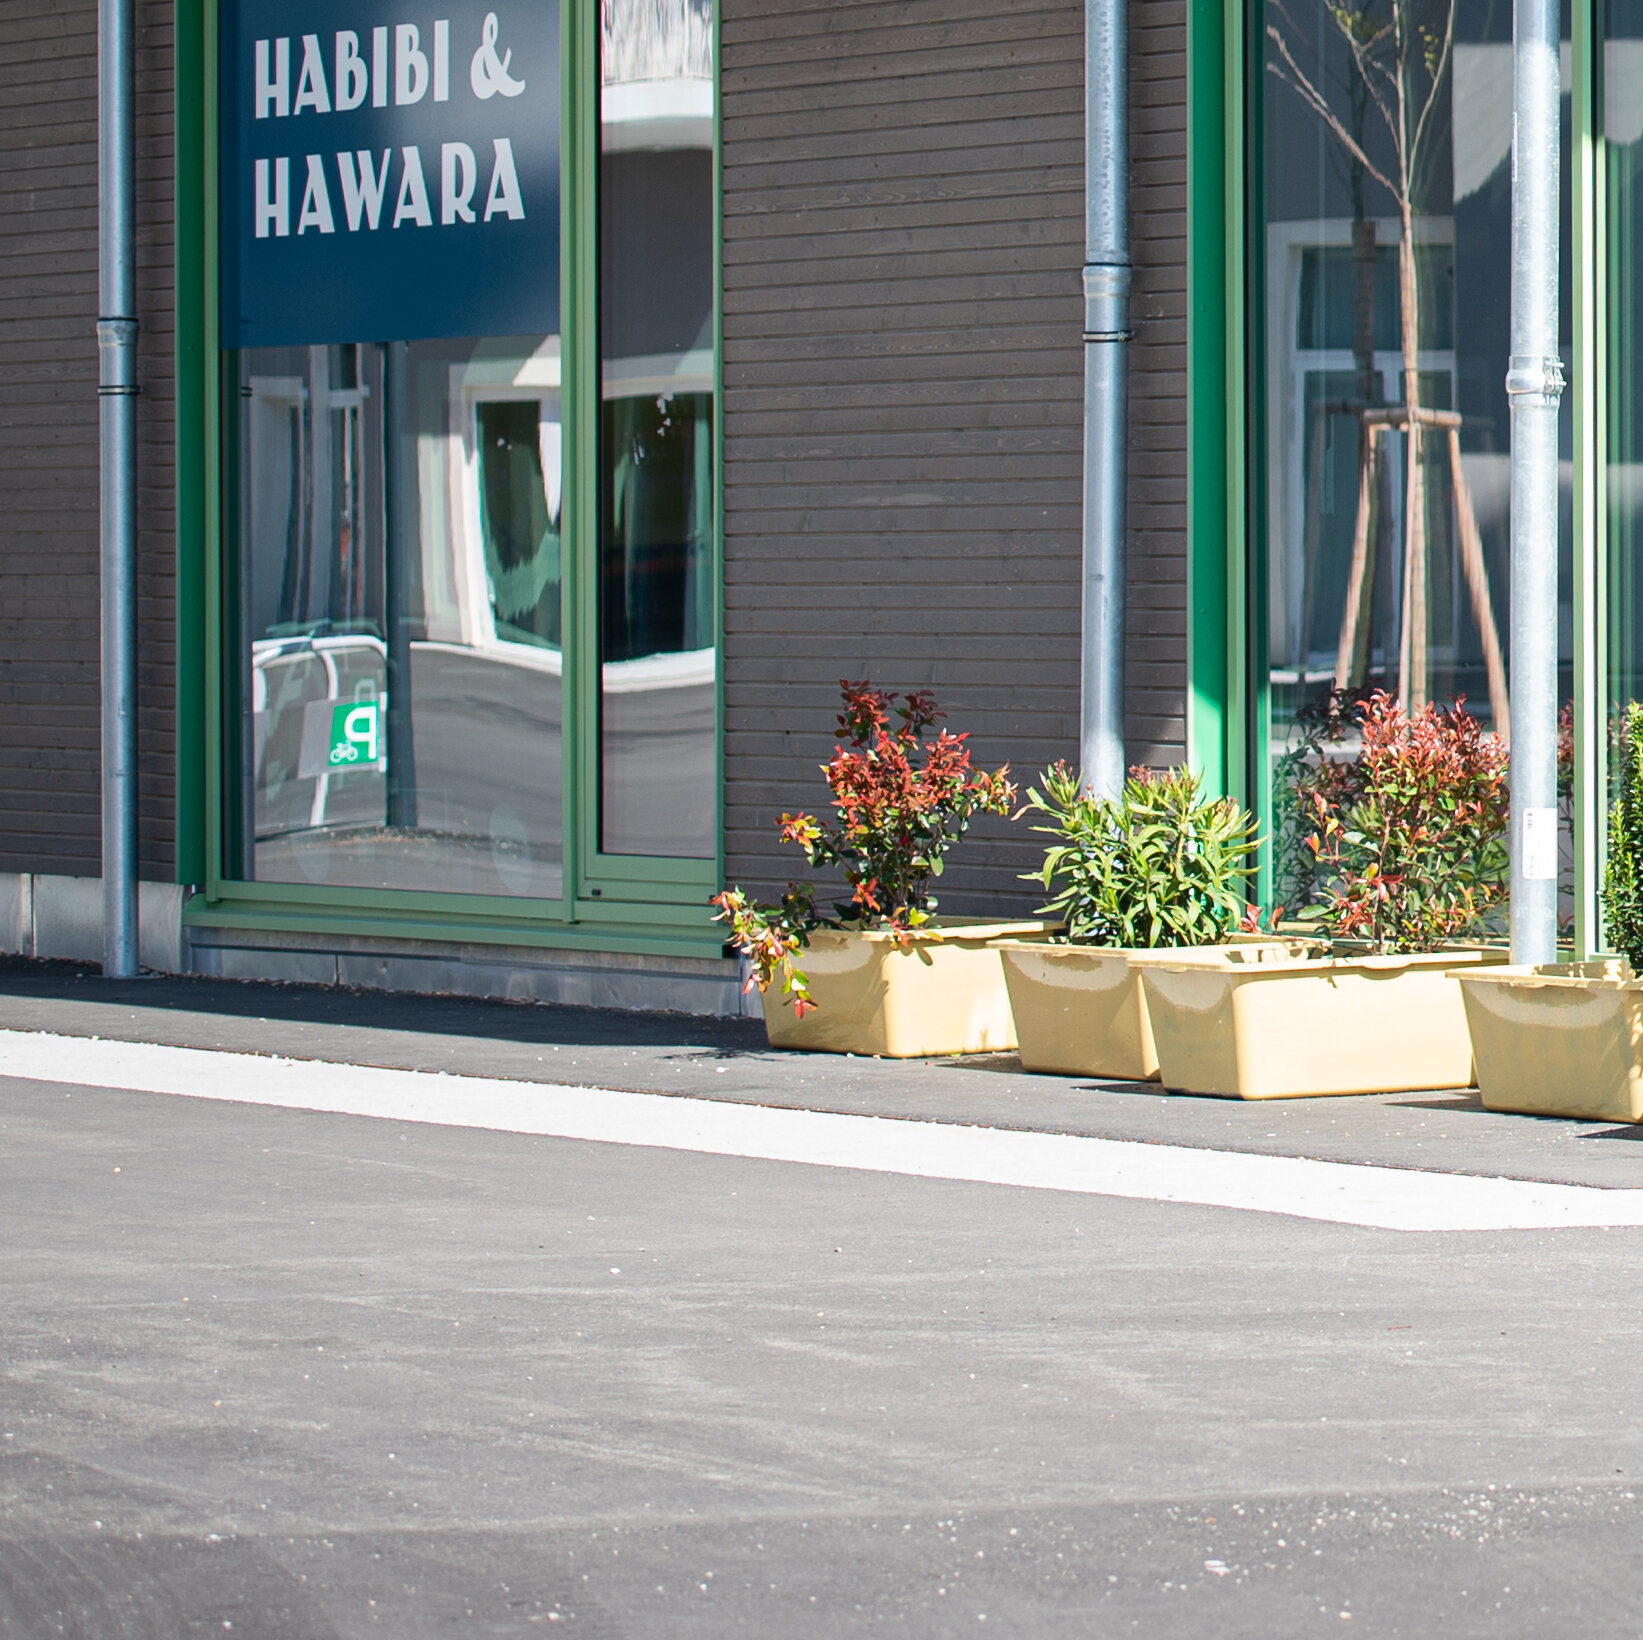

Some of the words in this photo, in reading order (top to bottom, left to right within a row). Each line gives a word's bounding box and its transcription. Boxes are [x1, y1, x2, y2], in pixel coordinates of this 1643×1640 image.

[254, 19, 450, 119] HABIBI
[470, 12, 526, 100] &
[254, 137, 526, 238] HAWARA
